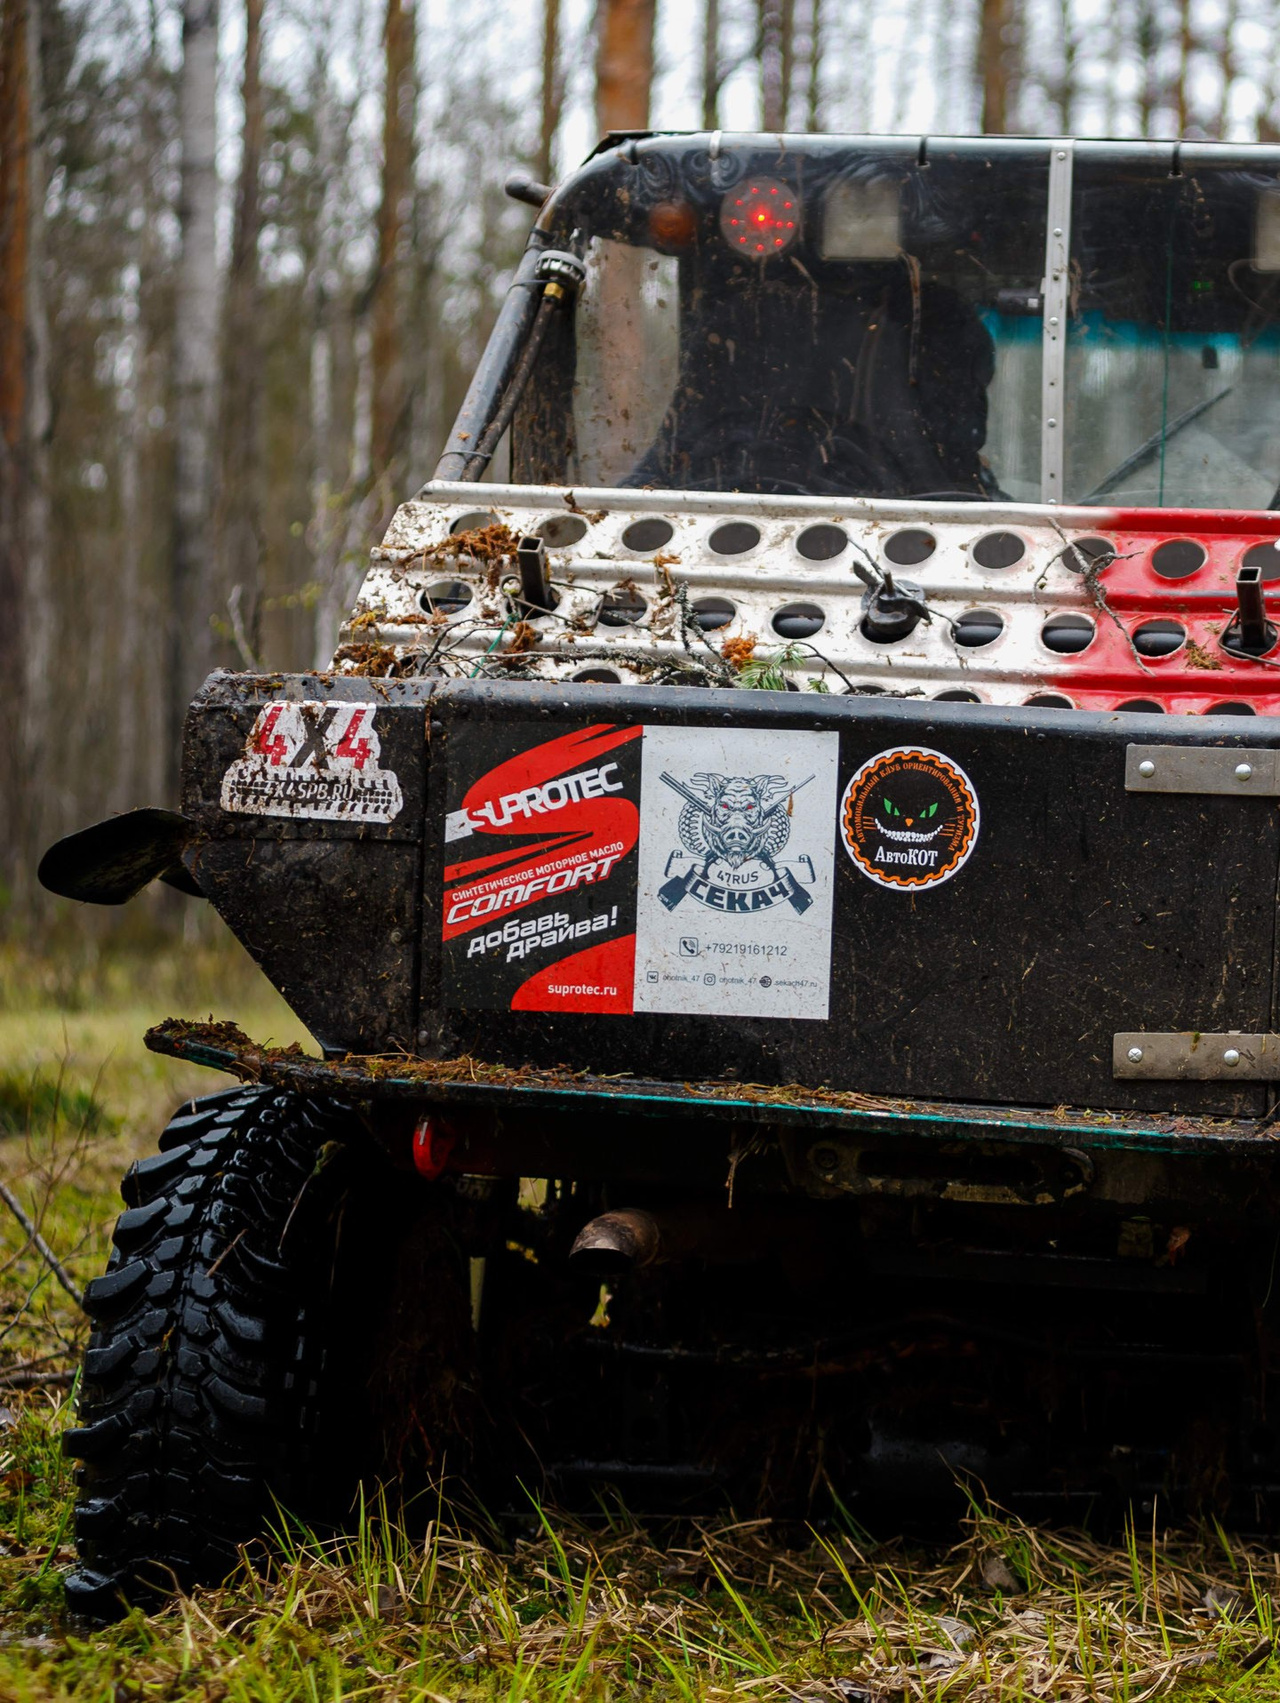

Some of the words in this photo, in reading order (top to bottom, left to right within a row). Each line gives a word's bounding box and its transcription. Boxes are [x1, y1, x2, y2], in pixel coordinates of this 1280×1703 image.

[879, 762, 901, 778] КЛУБ
[464, 762, 624, 829] SUPROTEC
[452, 868, 535, 902] СИНТЕТИЧЕСКОЕ
[536, 852, 588, 876] МОТОРНОЕ
[590, 841, 624, 860] МАСЛО
[716, 870, 759, 885] 47RUS
[446, 853, 621, 925] COMFORT
[689, 878, 790, 912] СЕКАЧ
[705, 942, 788, 957] +79219161212
[548, 983, 618, 997] suprotec.ru
